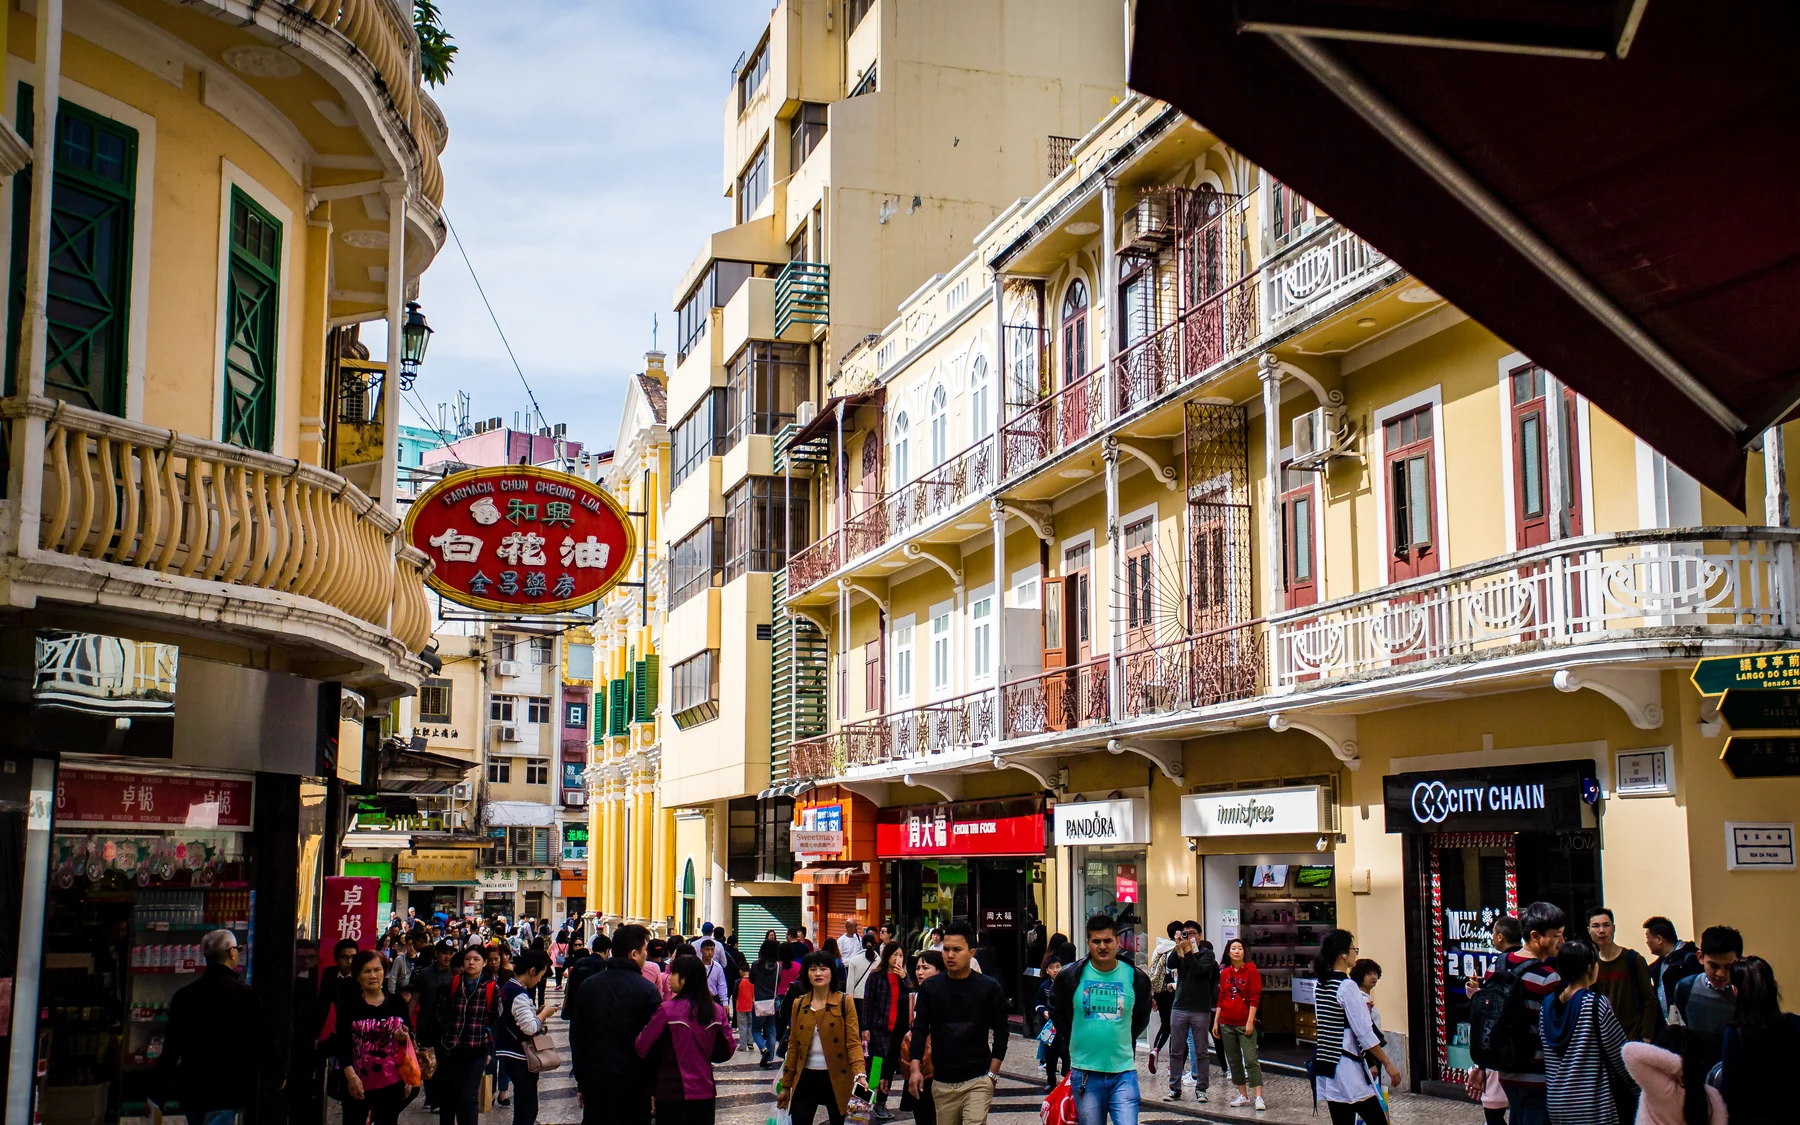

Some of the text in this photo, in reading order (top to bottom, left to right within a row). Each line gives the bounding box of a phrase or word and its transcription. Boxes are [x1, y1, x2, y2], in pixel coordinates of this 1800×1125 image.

[499, 479, 529, 493] CHUN
[535, 480, 576, 501] CHEONG
[504, 498, 576, 529] 和興
[429, 527, 611, 570] 白花油
[1735, 670, 1766, 681] LARGO
[1767, 669, 1780, 679] DO
[1763, 679, 1790, 688] Senado
[1763, 708, 1785, 717] CASA
[83, 772, 107, 780] BONJOUR
[113, 774, 135, 782] BONJOUR
[142, 776, 163, 784] BONJOUR
[169, 777, 190, 785] BONJOUR
[195, 779, 215, 787] BONJOUR
[1448, 783, 1546, 813] CITY CHAIN
[82, 812, 105, 820] BONJOUR
[1217, 797, 1275, 829] innisfree
[908, 814, 947, 849] 周大福
[969, 823, 979, 834] TAI
[980, 821, 997, 834] FOOK
[1066, 814, 1115, 837] PANDORA
[796, 833, 834, 843] Sweetmay
[986, 911, 1012, 921] 周大福
[1448, 911, 1477, 940] MERRY
[1460, 941, 1482, 951] HAPPY
[1091, 988, 1117, 996] FERRIS
[1091, 1005, 1115, 1013] WHEEL
